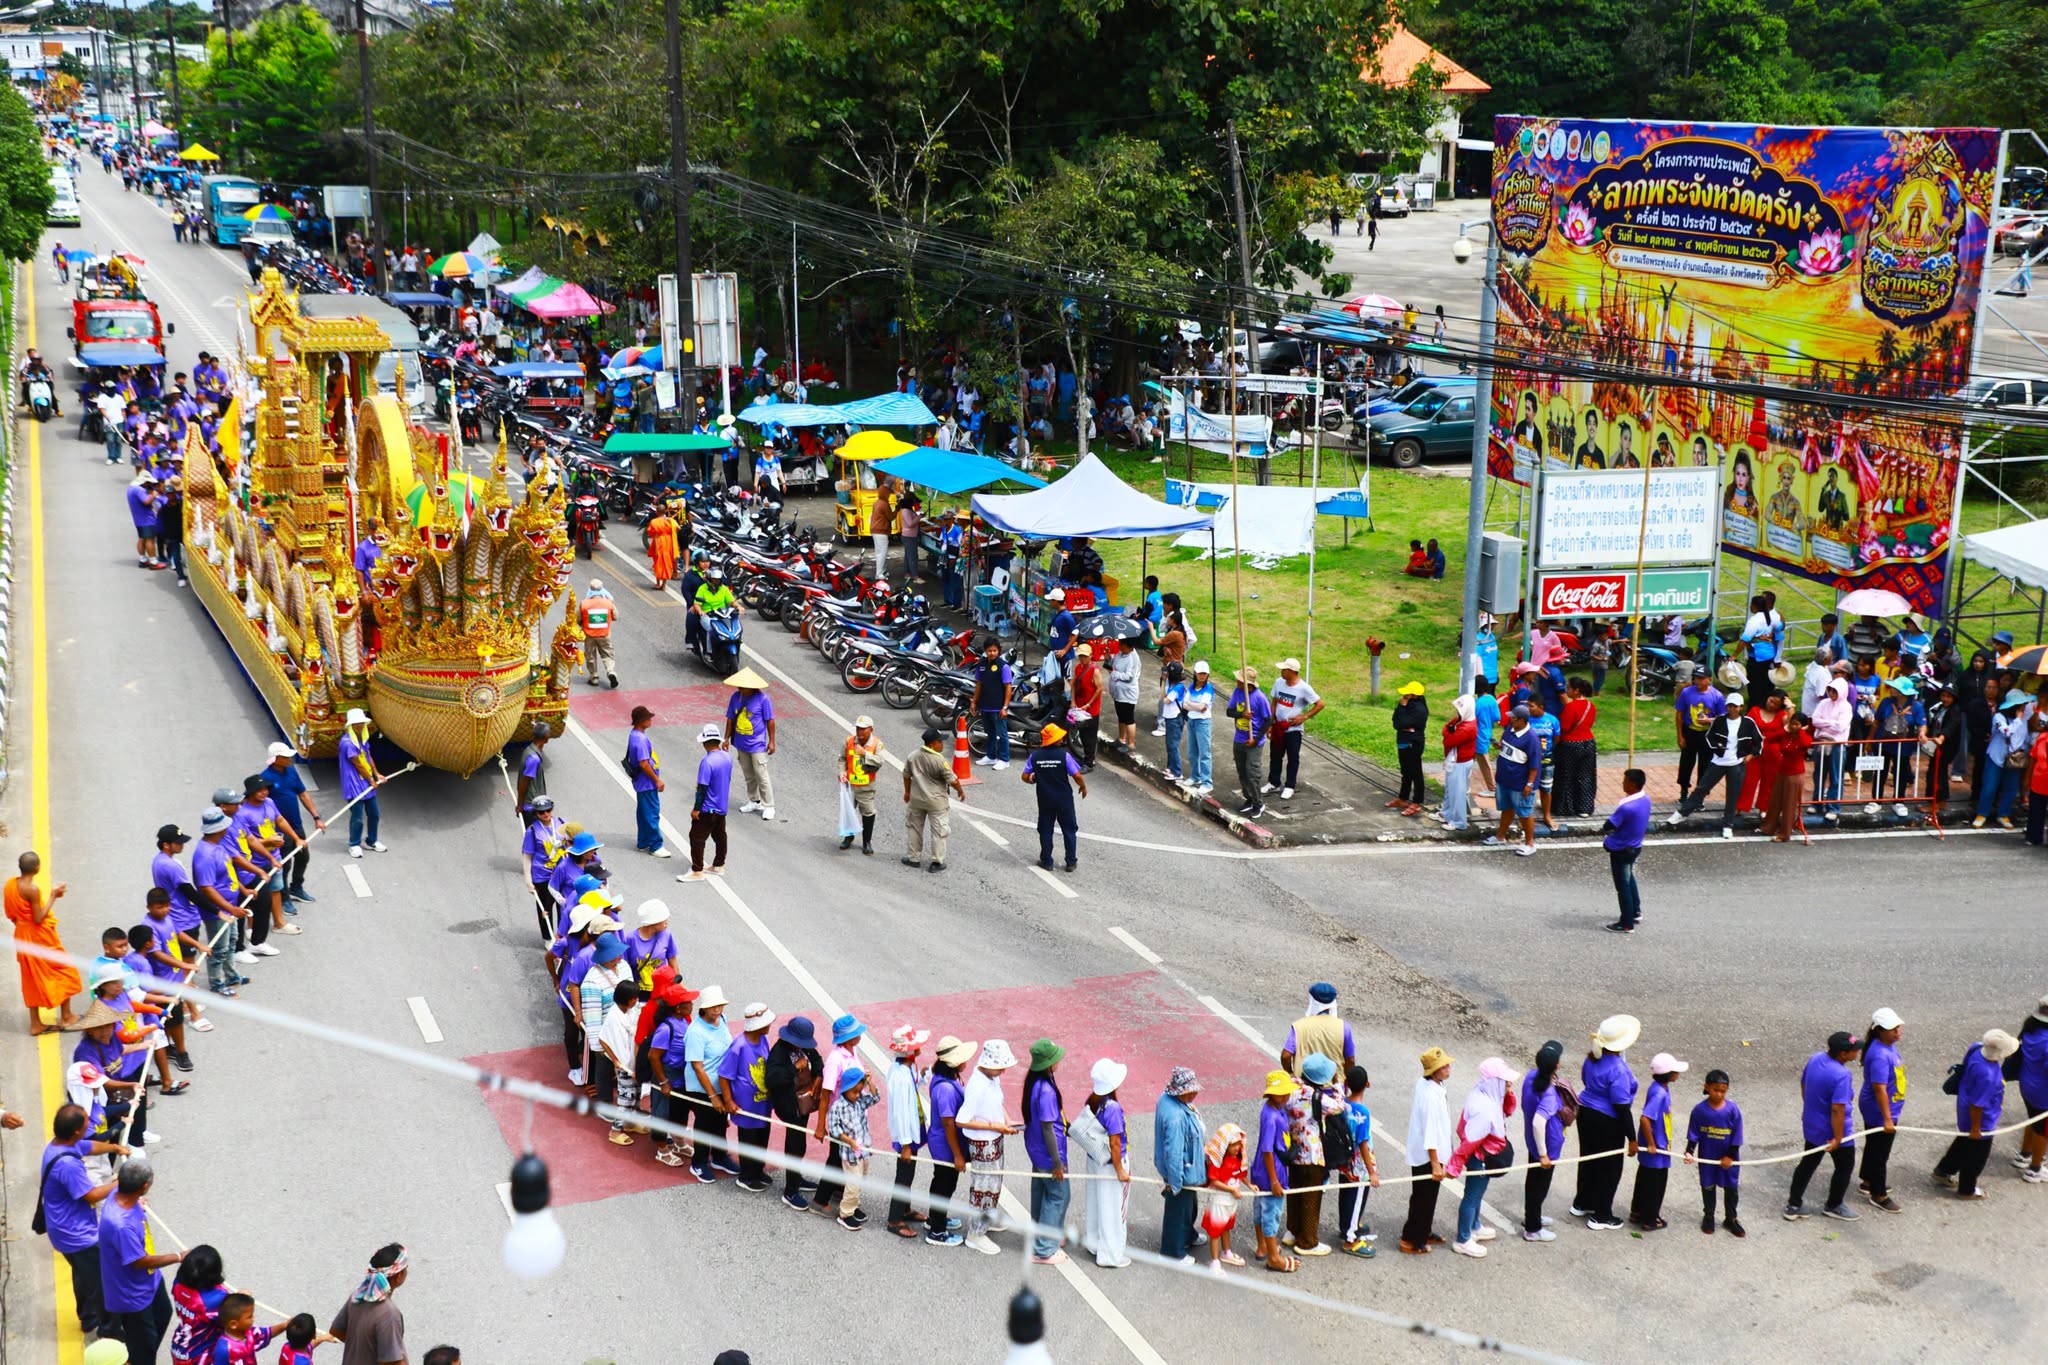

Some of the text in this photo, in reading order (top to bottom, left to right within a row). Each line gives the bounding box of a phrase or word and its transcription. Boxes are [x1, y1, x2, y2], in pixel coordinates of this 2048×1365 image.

[1654, 150, 1752, 175] โครงการงานประเพณี
[1603, 172, 1802, 230] ลากพระจังหวัดตรัง
[1636, 205, 1753, 235] ครั้งที่ ๒๓ ประจำปี ๒๕๖๙
[1618, 228, 1632, 242] วันที่
[1649, 235, 1676, 249] ตุลาคม
[1695, 239, 1739, 255] พฤศจิกายน
[1877, 275, 1939, 297] ลากพระ
[1547, 581, 1622, 610] Coca-Cola
